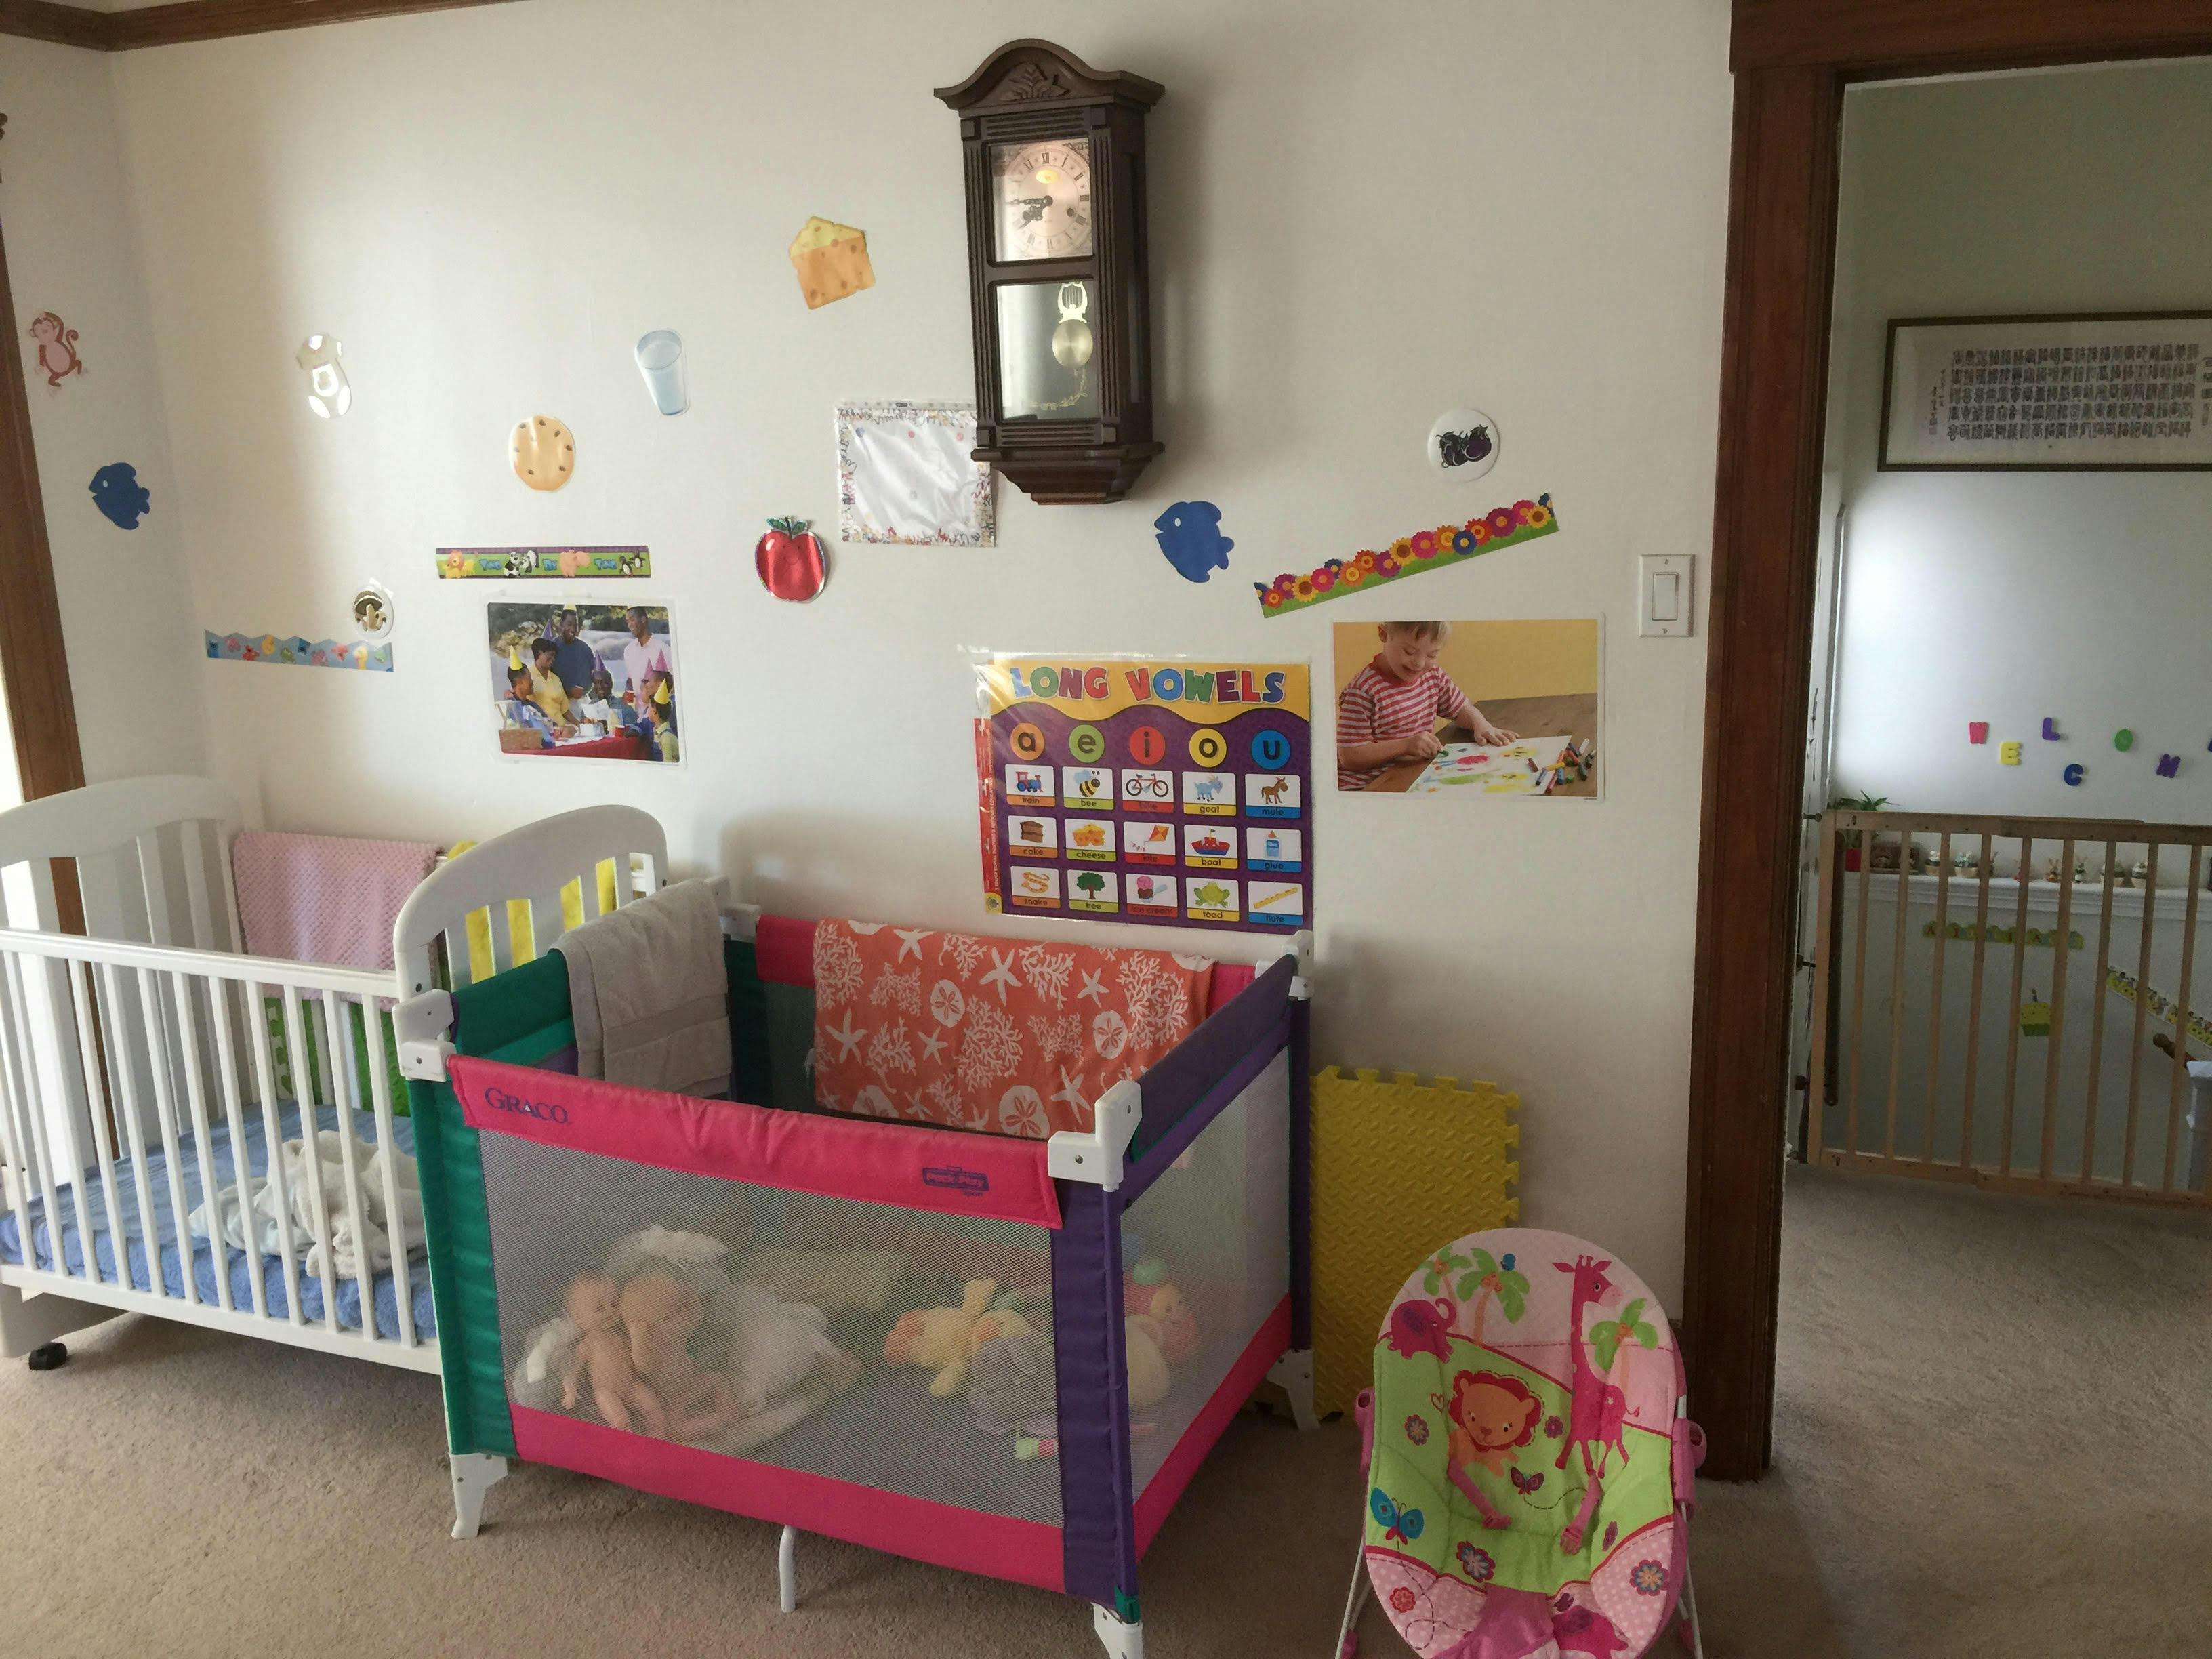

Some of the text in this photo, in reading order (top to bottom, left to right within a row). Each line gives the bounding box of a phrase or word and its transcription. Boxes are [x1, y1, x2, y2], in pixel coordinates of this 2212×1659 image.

[1010, 666, 1286, 704] LONG VOWELS
[1017, 731, 1036, 752] a
[1077, 734, 1097, 754] e
[1143, 731, 1151, 758] i
[1263, 739, 1280, 760] u
[1199, 805, 1220, 815] goat
[1261, 808, 1284, 816] mule
[1076, 851, 1106, 859] cheese
[1202, 858, 1221, 867] boat
[1265, 861, 1284, 871] glue
[1086, 902, 1102, 910] tree
[1203, 911, 1223, 919] toad
[485, 1087, 568, 1124] GRACO
